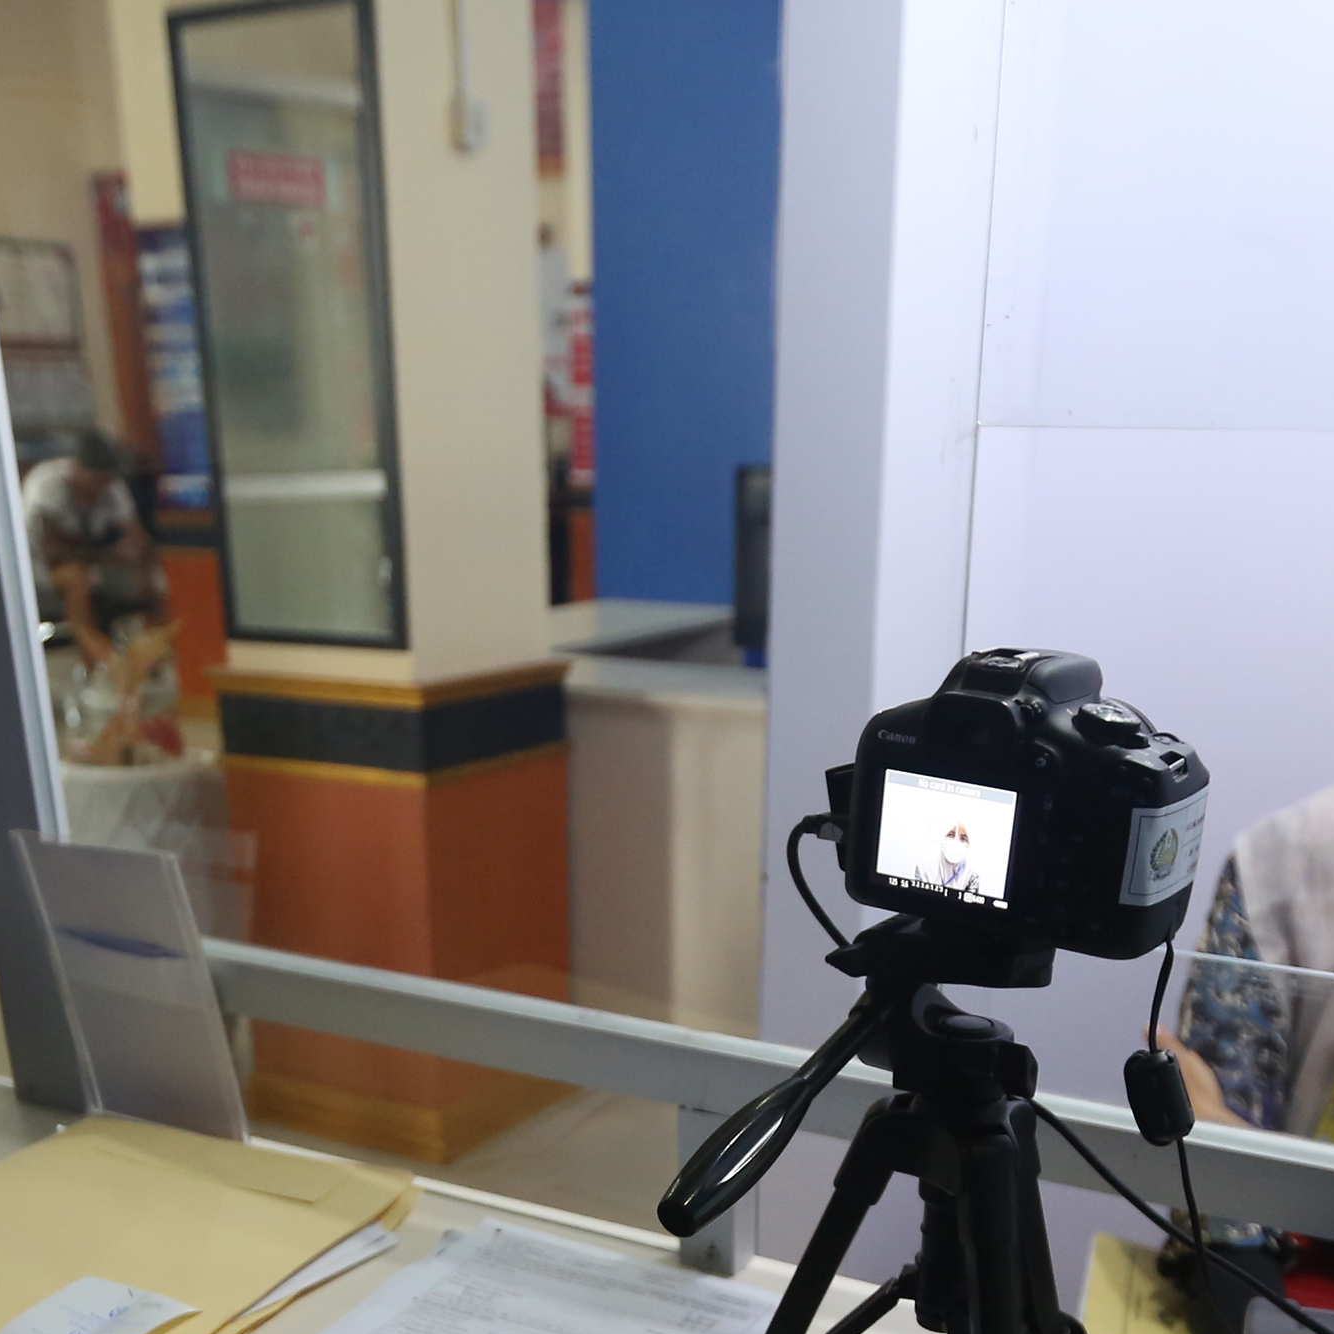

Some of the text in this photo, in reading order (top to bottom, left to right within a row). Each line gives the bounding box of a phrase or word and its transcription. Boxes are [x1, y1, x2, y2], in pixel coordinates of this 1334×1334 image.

[877, 729, 917, 745] Canon
[918, 778, 982, 798] No card in camera
